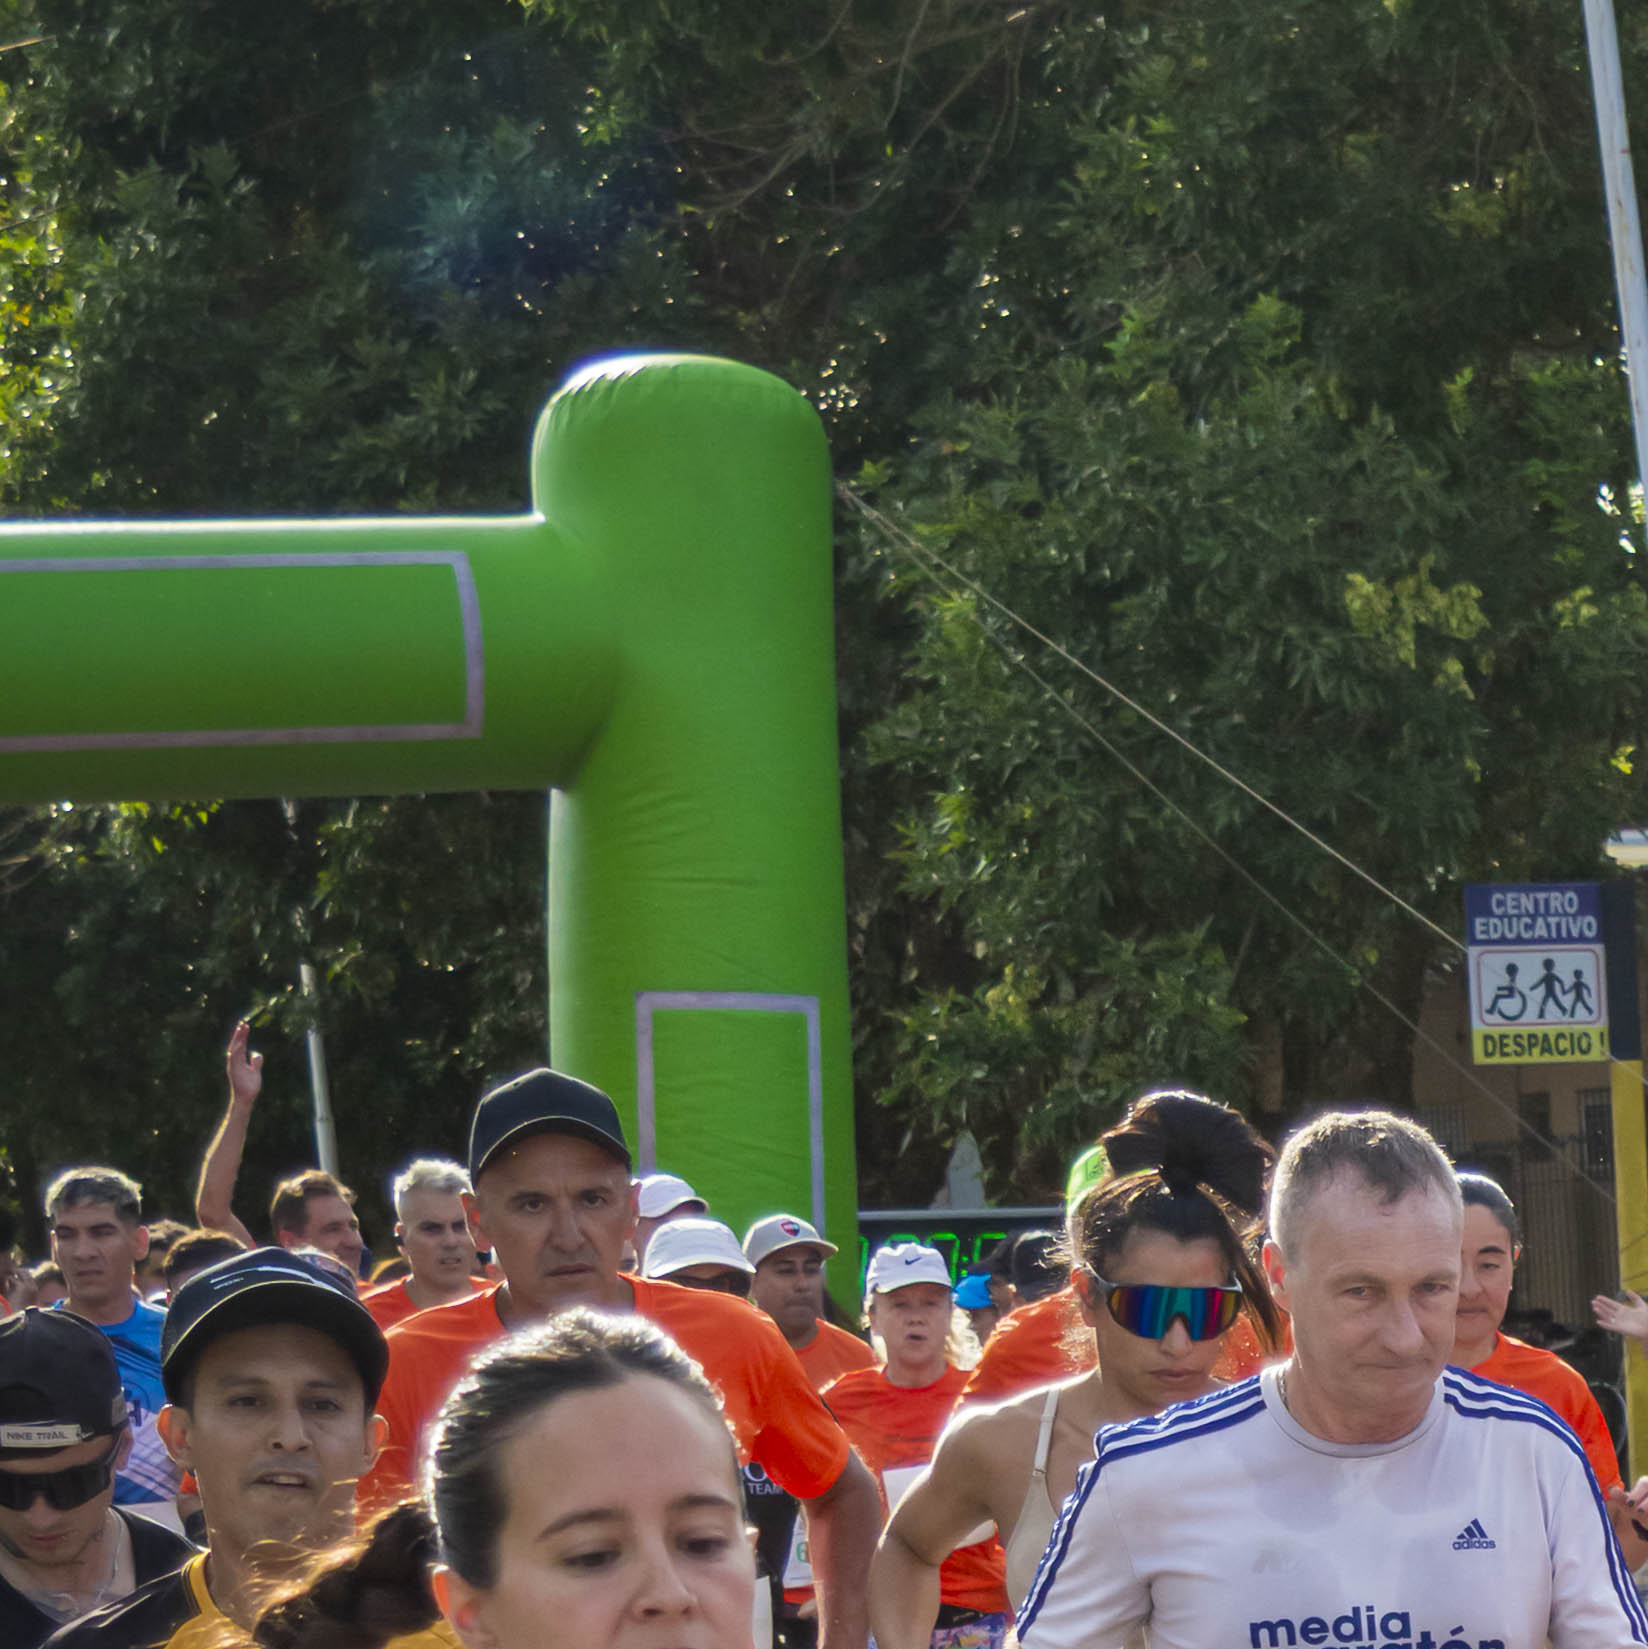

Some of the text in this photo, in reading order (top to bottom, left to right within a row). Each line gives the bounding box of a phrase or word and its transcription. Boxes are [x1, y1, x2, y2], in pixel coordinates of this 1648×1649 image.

[1491, 891, 1579, 916] CENTRO
[1474, 915, 1598, 940] EDUCATIVO
[1483, 1032, 1592, 1058] DESPACIO
[6, 1431, 67, 1440] NIKE TRAIL
[747, 1482, 784, 1495] TEAM
[1452, 1538, 1496, 1550] adidas
[1249, 1605, 1412, 1649] media
